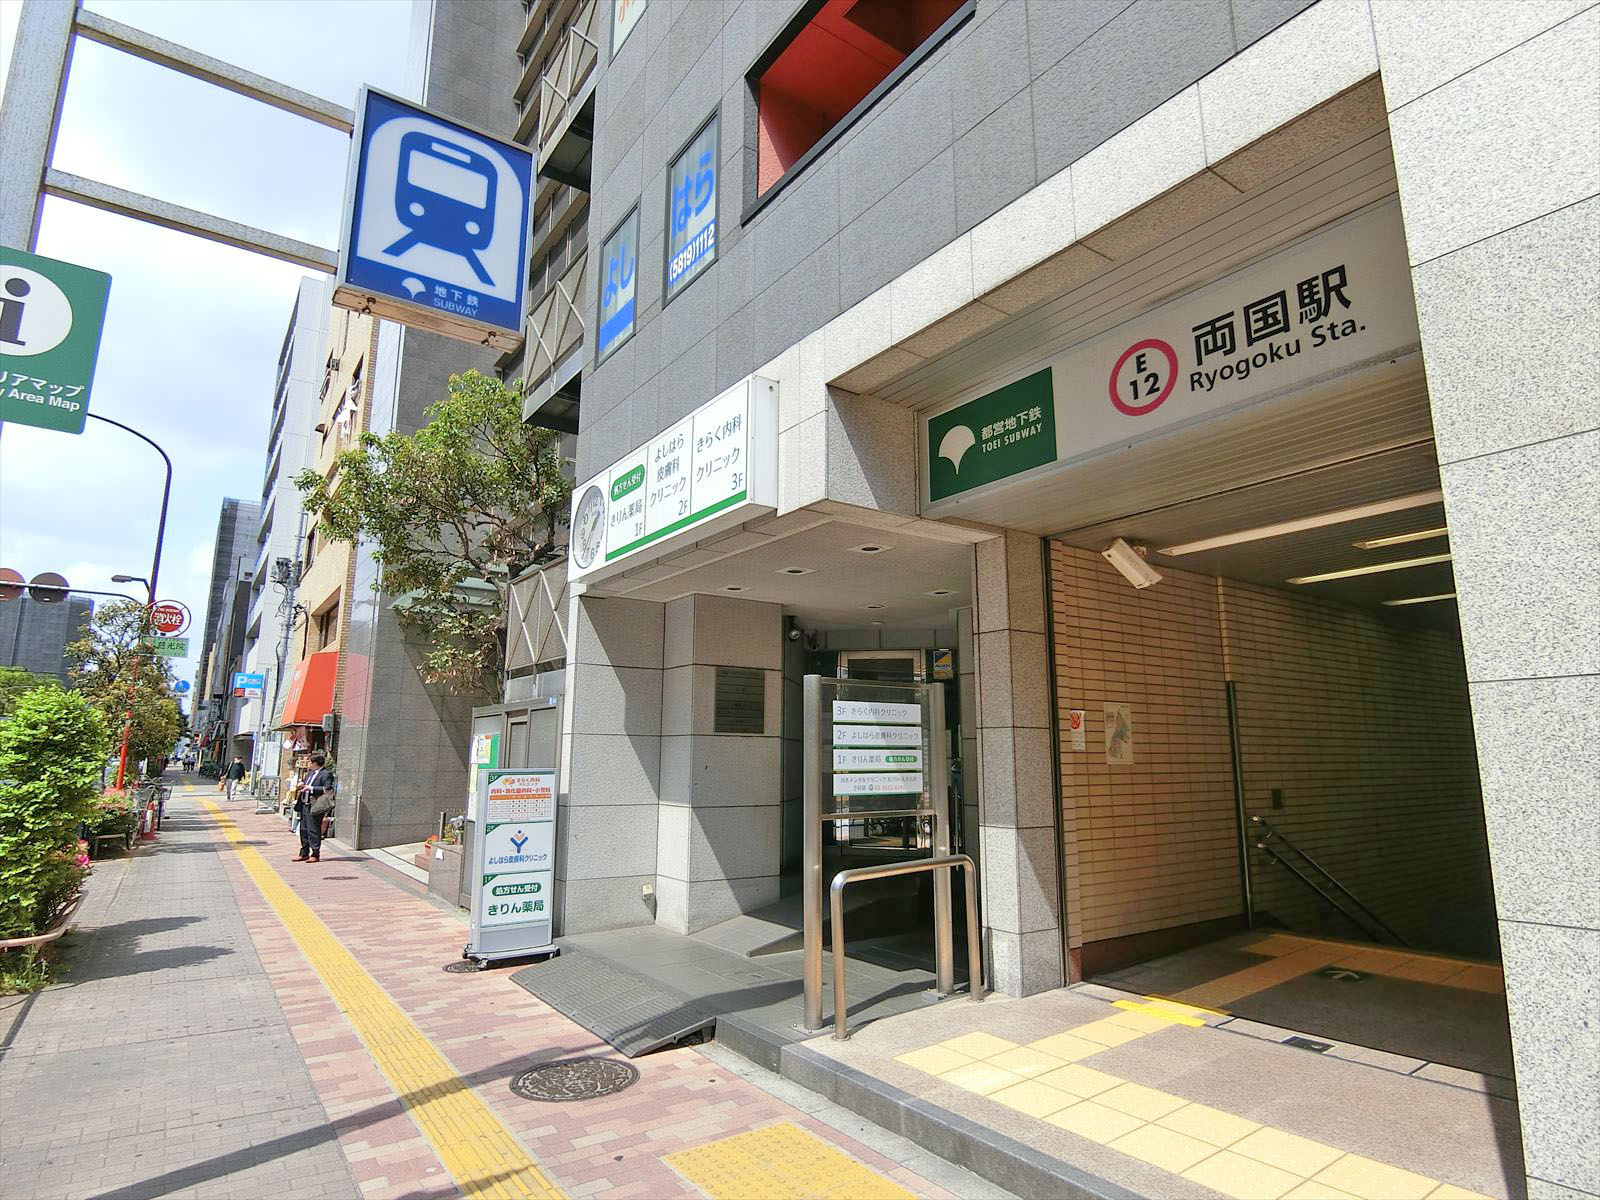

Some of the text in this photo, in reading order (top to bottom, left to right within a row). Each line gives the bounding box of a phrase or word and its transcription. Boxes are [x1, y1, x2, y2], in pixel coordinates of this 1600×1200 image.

[672, 152, 714, 239] はら
[669, 223, 715, 283] (5819)1112
[603, 243, 635, 308] よし
[433, 297, 478, 317] SUBWAY
[434, 284, 479, 307] 地下鉄
[1192, 264, 1351, 367] 両国駅
[1135, 353, 1147, 374] E
[1190, 318, 1366, 392] Ryogoku Sta.
[1129, 372, 1160, 400] 12
[8, 388, 45, 404] Area
[48, 395, 80, 412] Map
[697, 413, 742, 453] きらく内科
[981, 406, 1042, 440] 都営地下鉄
[654, 433, 684, 463] よしはら
[982, 423, 1042, 453] TOEI SUBWAY
[657, 456, 680, 482] 皮膚科
[697, 447, 740, 483] クリニック
[650, 476, 687, 507] クリニック
[731, 472, 743, 491] 3F
[611, 499, 642, 527] きりん薬局
[678, 500, 688, 516] 2F
[635, 522, 643, 537] 1F
[237, 675, 248, 688] P
[837, 705, 908, 717] 3F きらく内科クリニック
[837, 729, 846, 740] 2F
[837, 754, 847, 765] 1F
[851, 755, 882, 764] きりん薬局
[489, 853, 547, 864] よしはら皮膚科クリニック
[495, 884, 538, 895] 処方せん受付
[488, 900, 544, 916] きりん薬局
